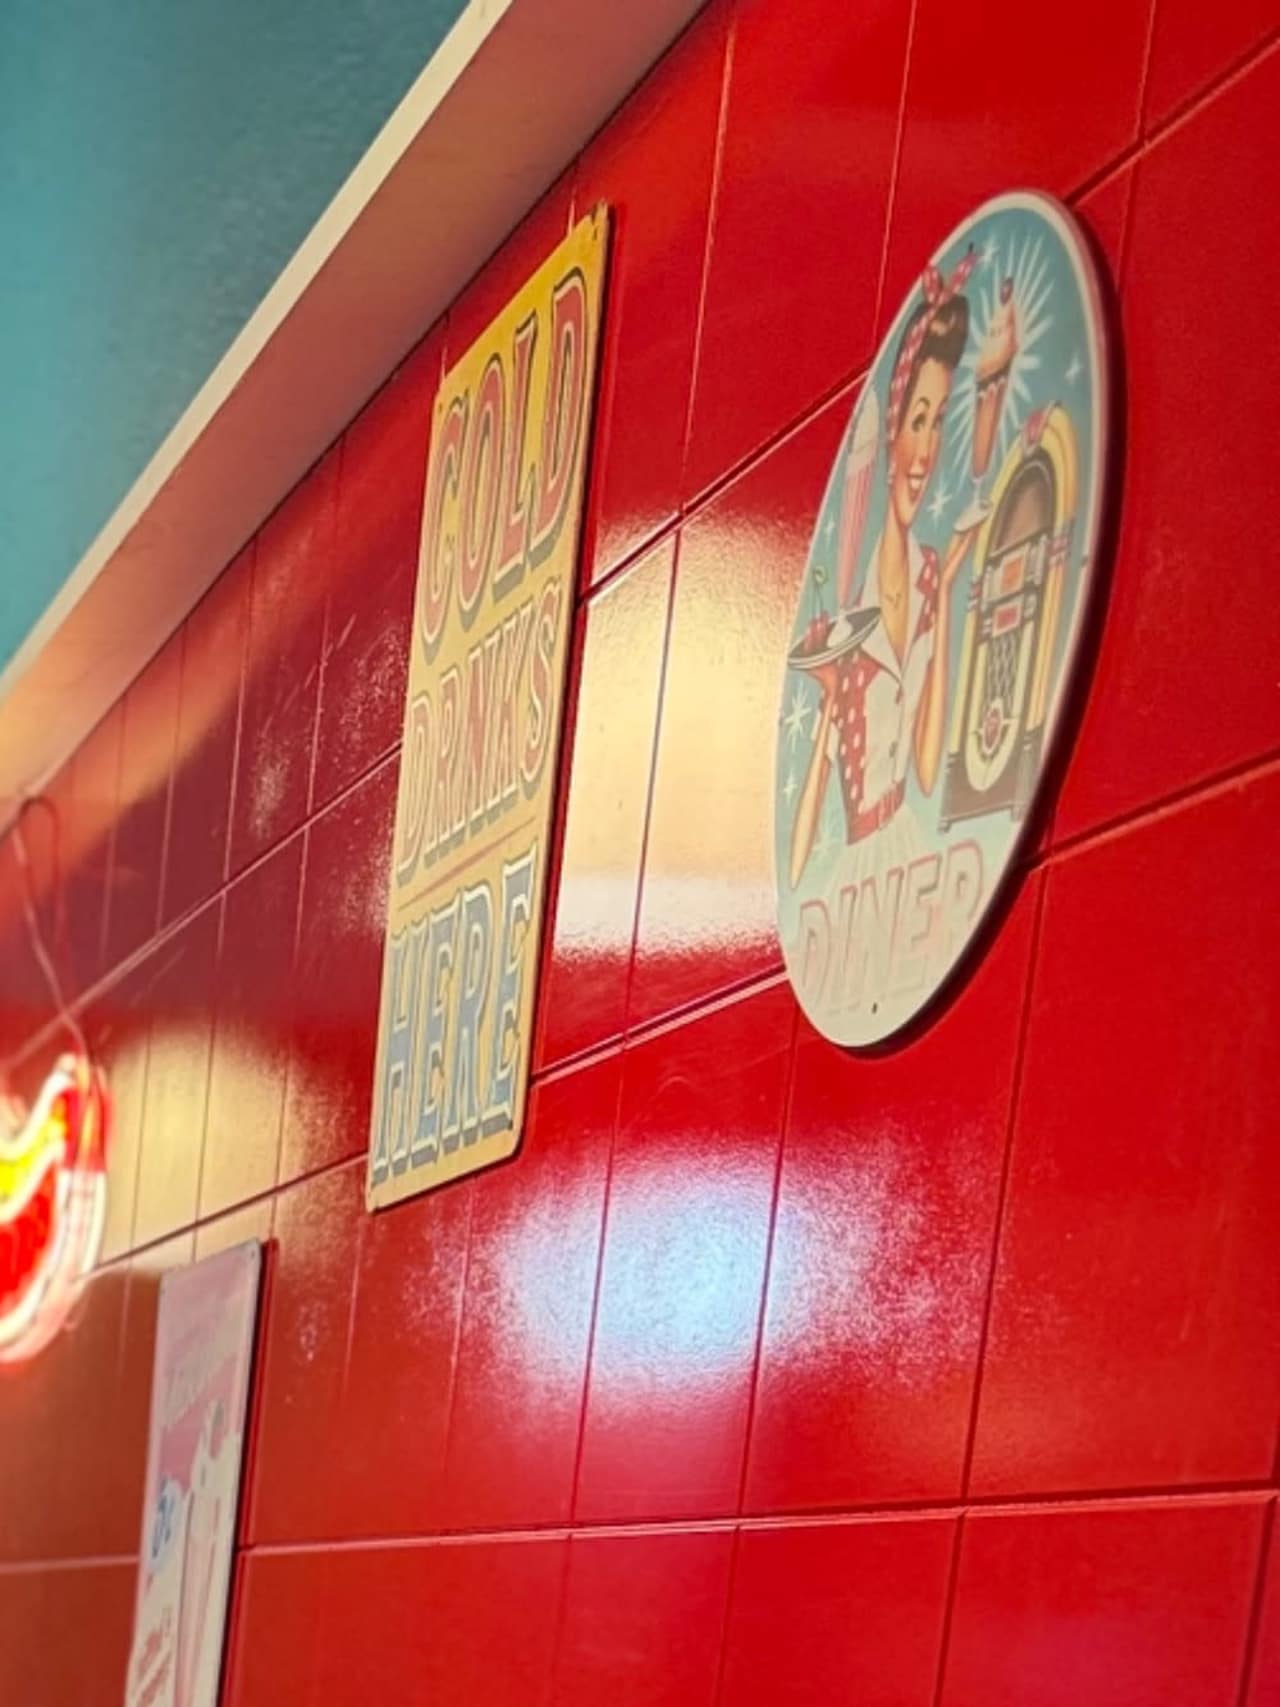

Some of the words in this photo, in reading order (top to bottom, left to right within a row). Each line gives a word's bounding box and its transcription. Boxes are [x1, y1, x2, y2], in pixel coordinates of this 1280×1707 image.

[420, 267, 587, 664] COLD
[371, 843, 536, 1187] HERE
[794, 838, 983, 1012] DINER
